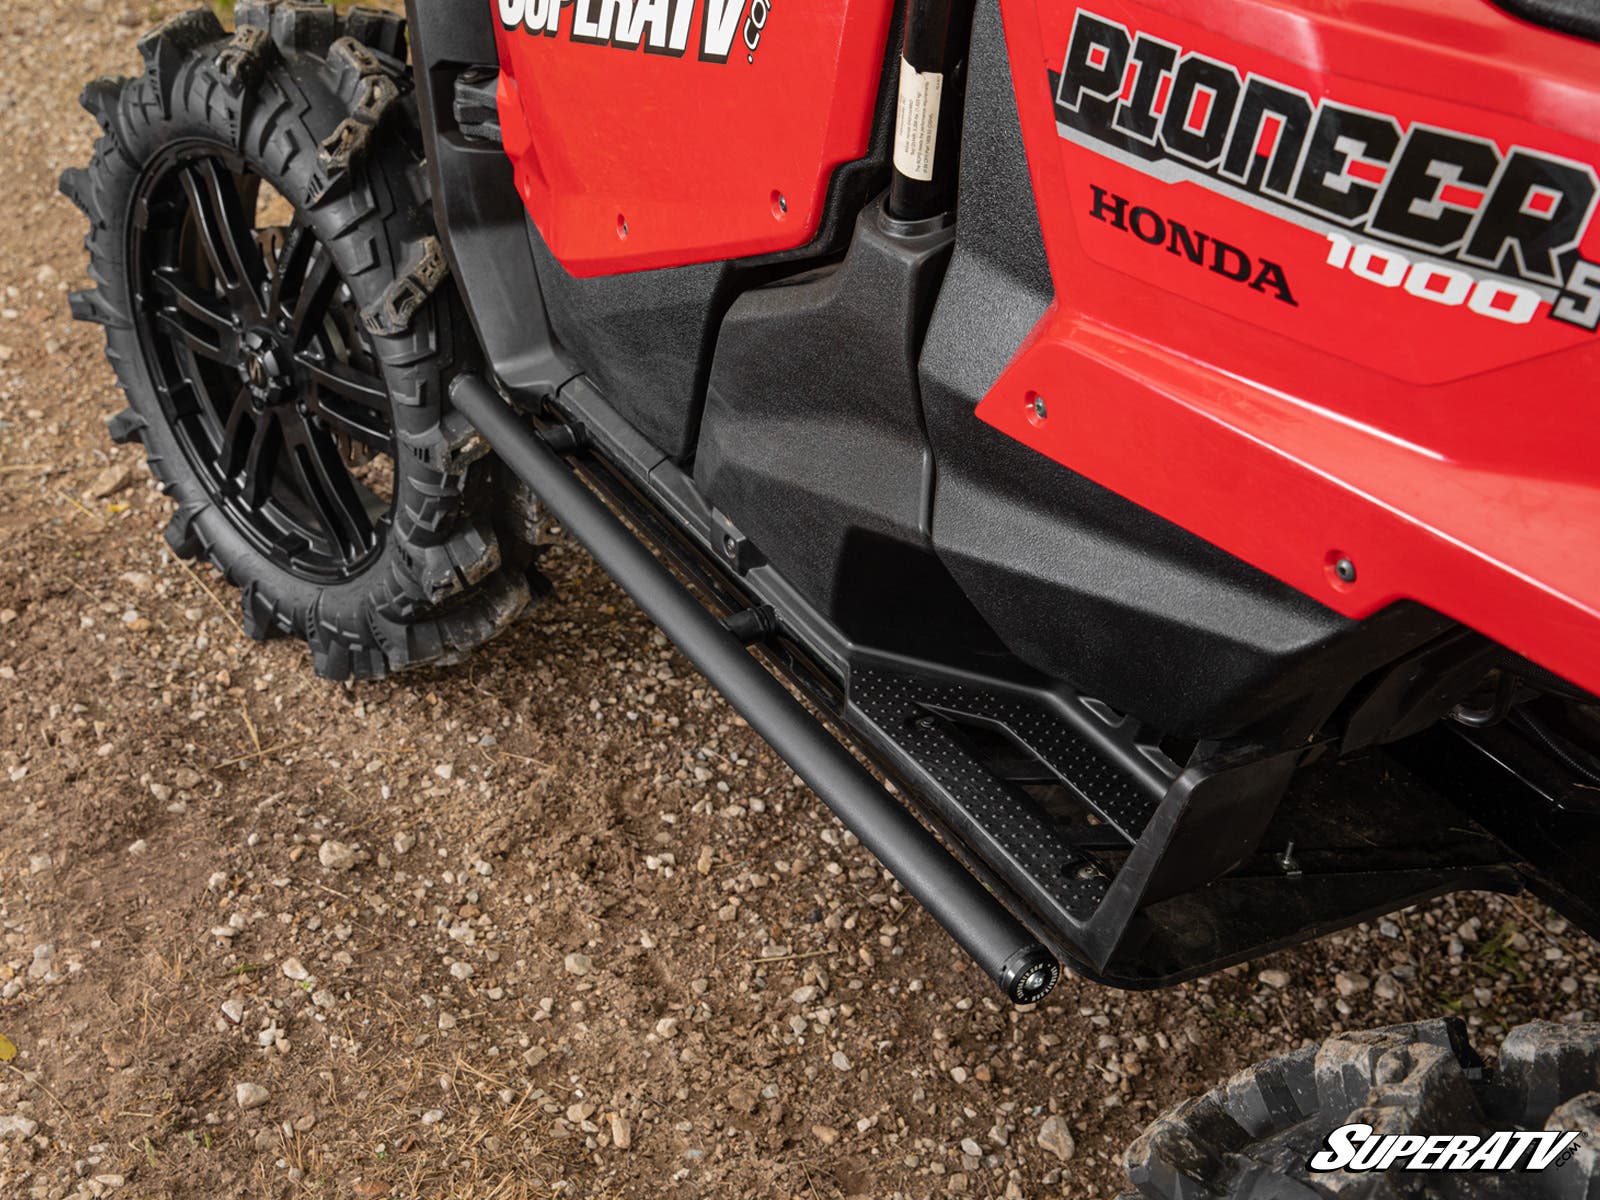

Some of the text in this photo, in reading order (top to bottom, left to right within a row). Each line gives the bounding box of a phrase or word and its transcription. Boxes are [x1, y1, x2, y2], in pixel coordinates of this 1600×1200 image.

[1056, 7, 1600, 288] PIONEER
[1089, 184, 1298, 307] HONDA
[1326, 231, 1542, 324] 1000
